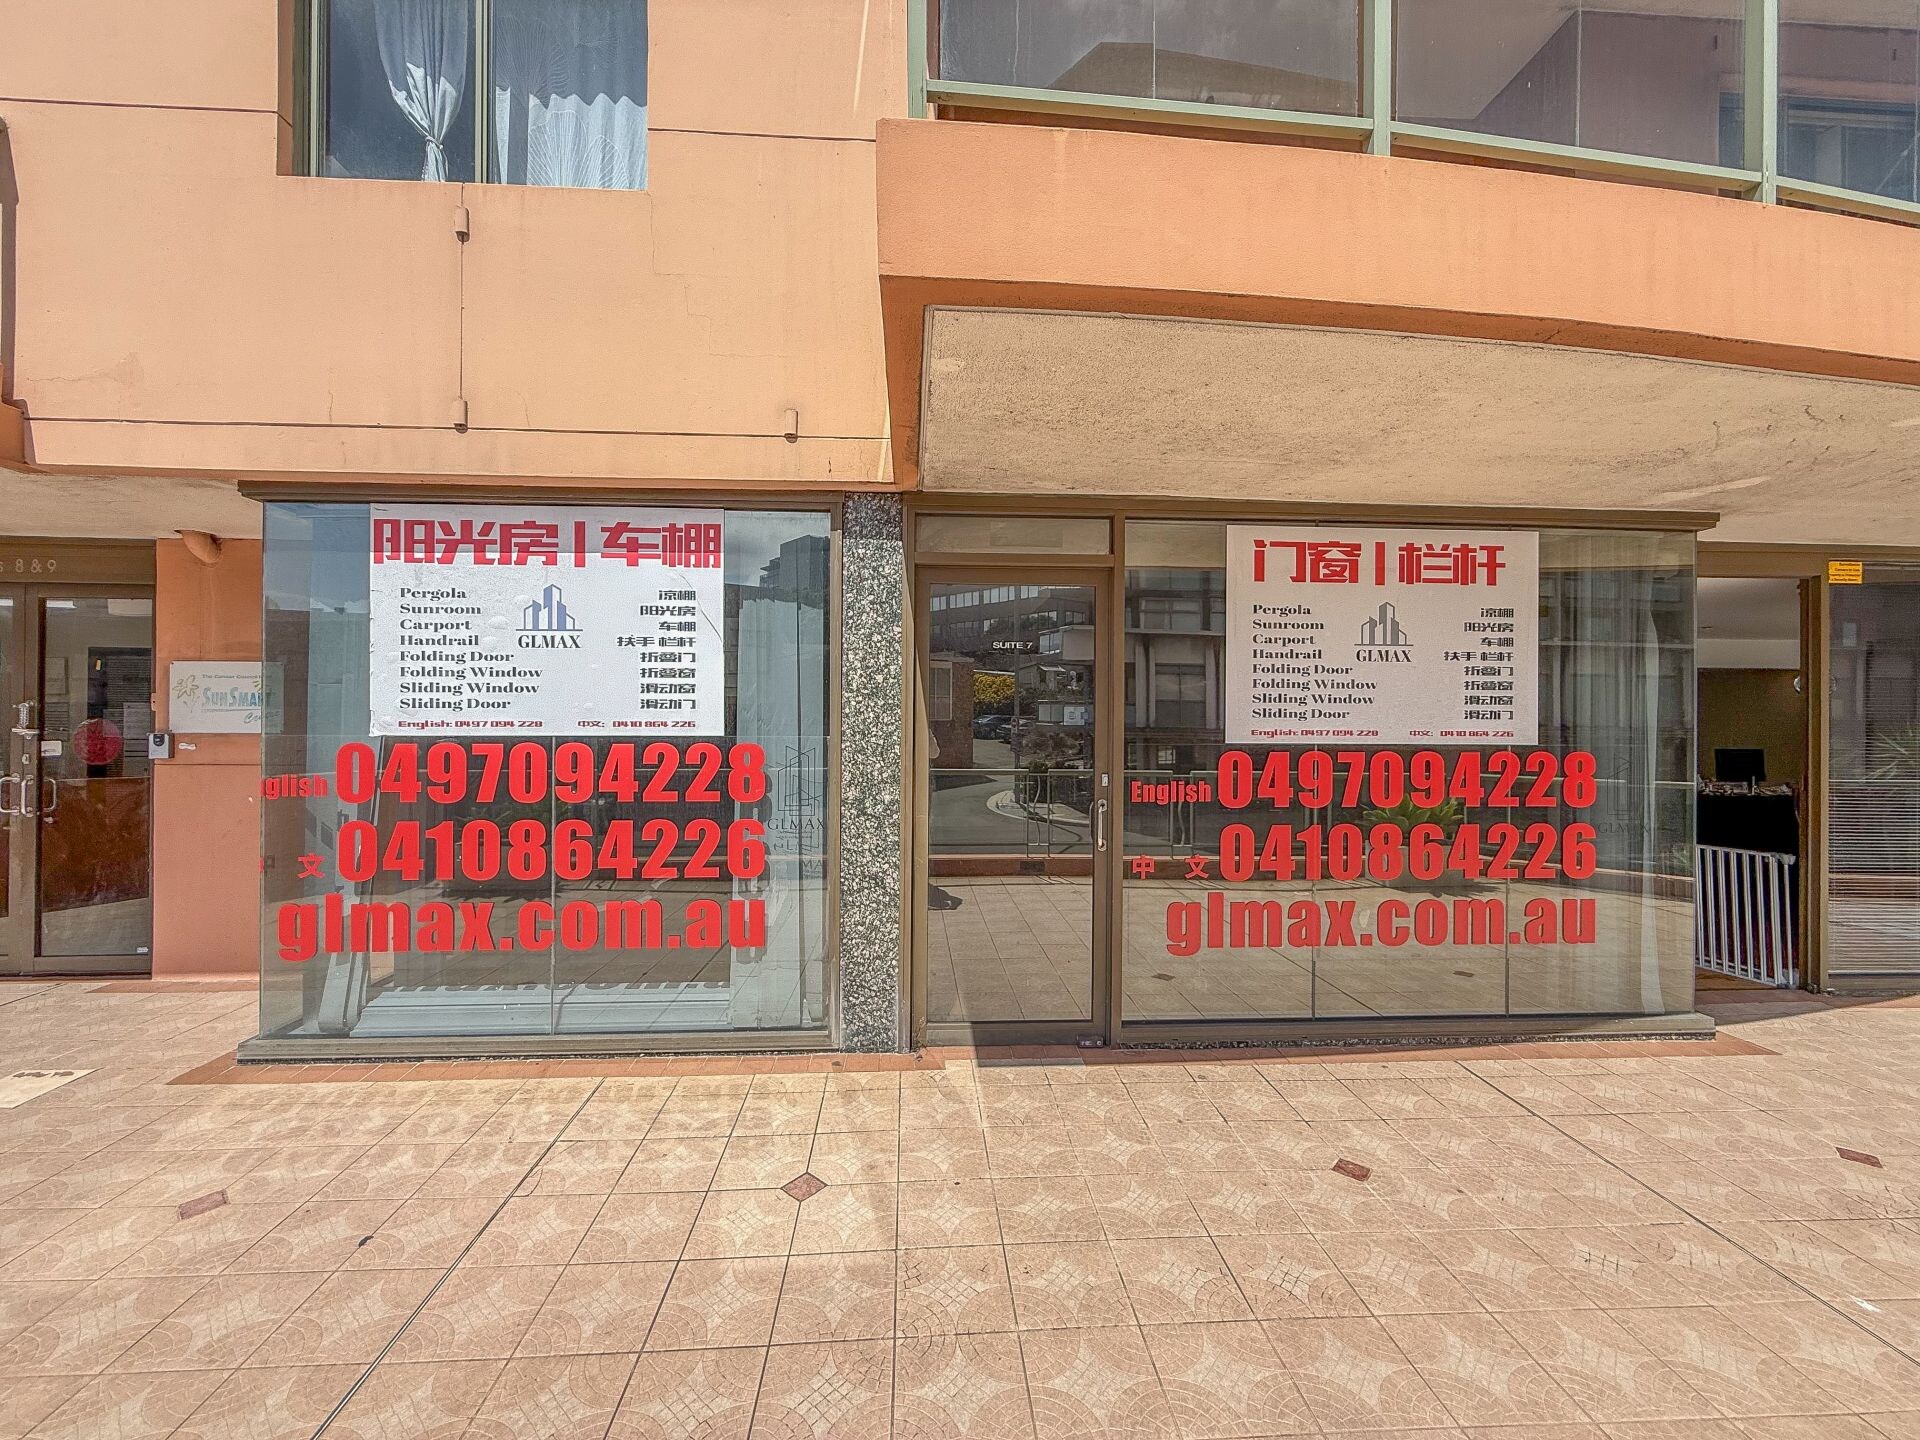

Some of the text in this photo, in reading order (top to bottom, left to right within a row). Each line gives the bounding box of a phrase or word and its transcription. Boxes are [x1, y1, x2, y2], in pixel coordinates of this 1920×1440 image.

[601, 521, 721, 568] 车棚
[1253, 539, 1362, 584] 门窗
[1398, 542, 1507, 587] 栏杆
[399, 587, 467, 601] Pergola
[399, 603, 482, 615] Sunroom
[640, 605, 697, 616] 阳光房
[1252, 604, 1312, 618] Pergola
[399, 618, 473, 633] Carport
[658, 621, 697, 632] 车棚
[1252, 619, 1325, 630] Sunroom
[1463, 622, 1514, 632] 阳光房
[399, 634, 480, 648] Handrail
[517, 634, 582, 649] GLMAX
[616, 635, 697, 647] 扶手 栏杆
[992, 641, 1033, 649] SUITE 7
[1252, 634, 1317, 648] Carport
[1480, 637, 1514, 647] 车棚
[399, 650, 515, 664] Folding Door
[640, 652, 697, 663] 折叠门
[1252, 649, 1322, 660] Handrail
[1356, 649, 1412, 663] GLMAX
[1443, 651, 1514, 662] 扶手 栏杆
[399, 666, 543, 680] Folding Window
[640, 668, 697, 678] 折叠窗
[1252, 663, 1353, 677] Folding Door
[1463, 666, 1514, 676] 折叠门
[399, 682, 540, 696] Sliding Window
[640, 683, 697, 694] 滑动窗
[1252, 678, 1378, 692] Folding Window
[1463, 680, 1514, 691] 折叠窗
[399, 697, 511, 712] Sliding Door
[640, 699, 697, 710] 滑动门
[1252, 693, 1375, 707] Sliding Window
[1463, 695, 1514, 706] 滑动窗
[1251, 708, 1351, 722] Sliding Door
[1463, 710, 1514, 720] 滑动门
[398, 720, 543, 730] English: 0497 094 228
[612, 720, 643, 728] 0410
[644, 720, 669, 728] 864
[670, 720, 696, 728] 226
[1250, 729, 1299, 738] English:
[260, 740, 767, 806] glish 0497094228
[1130, 750, 1598, 810] English 0497094228
[337, 818, 767, 883] 0410864226
[1218, 821, 1598, 883] 0410864226
[276, 892, 767, 963] glmax.com.au
[1165, 891, 1597, 958] glmax.com.au
